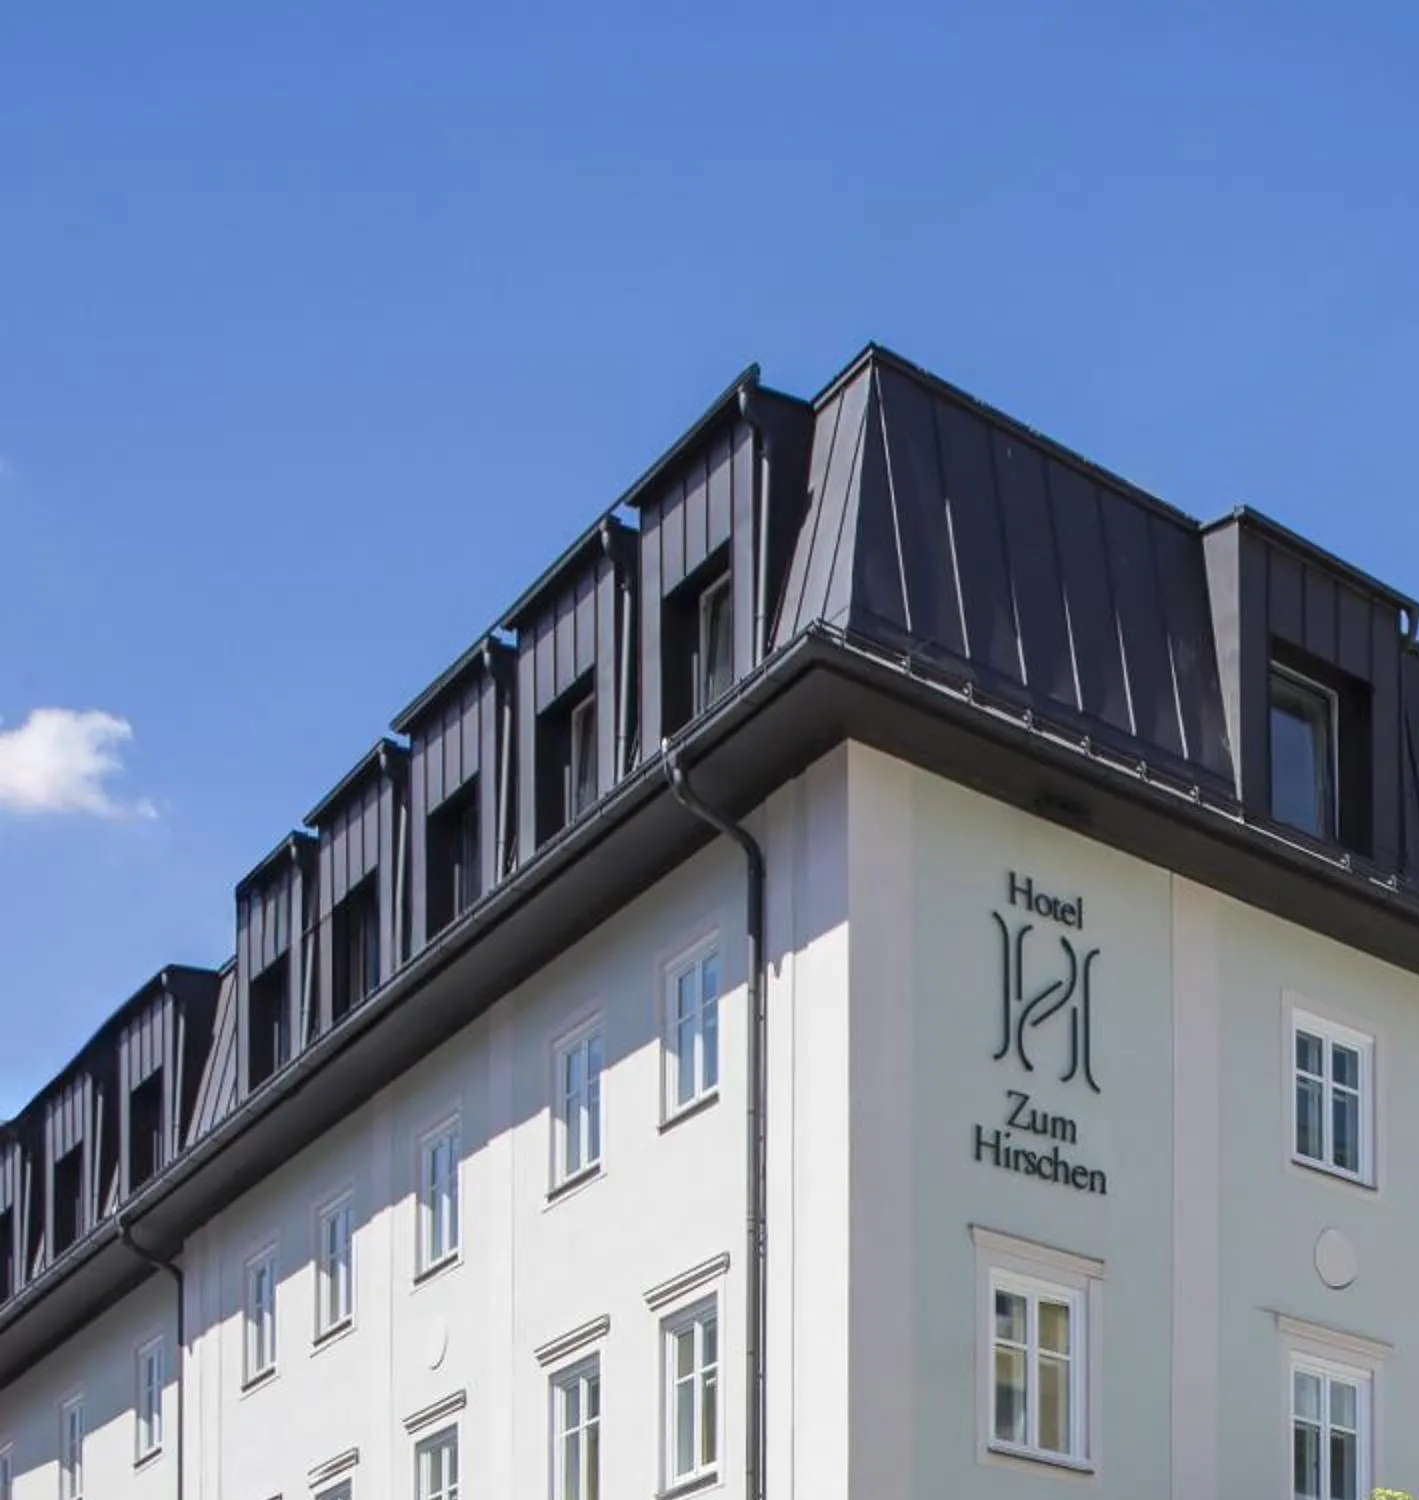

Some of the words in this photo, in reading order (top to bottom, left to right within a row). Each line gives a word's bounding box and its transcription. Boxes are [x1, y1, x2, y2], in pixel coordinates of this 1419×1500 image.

[1007, 870, 1084, 930] Hotel
[1006, 1089, 1078, 1144] Zum
[973, 1123, 1108, 1195] Hirschen
